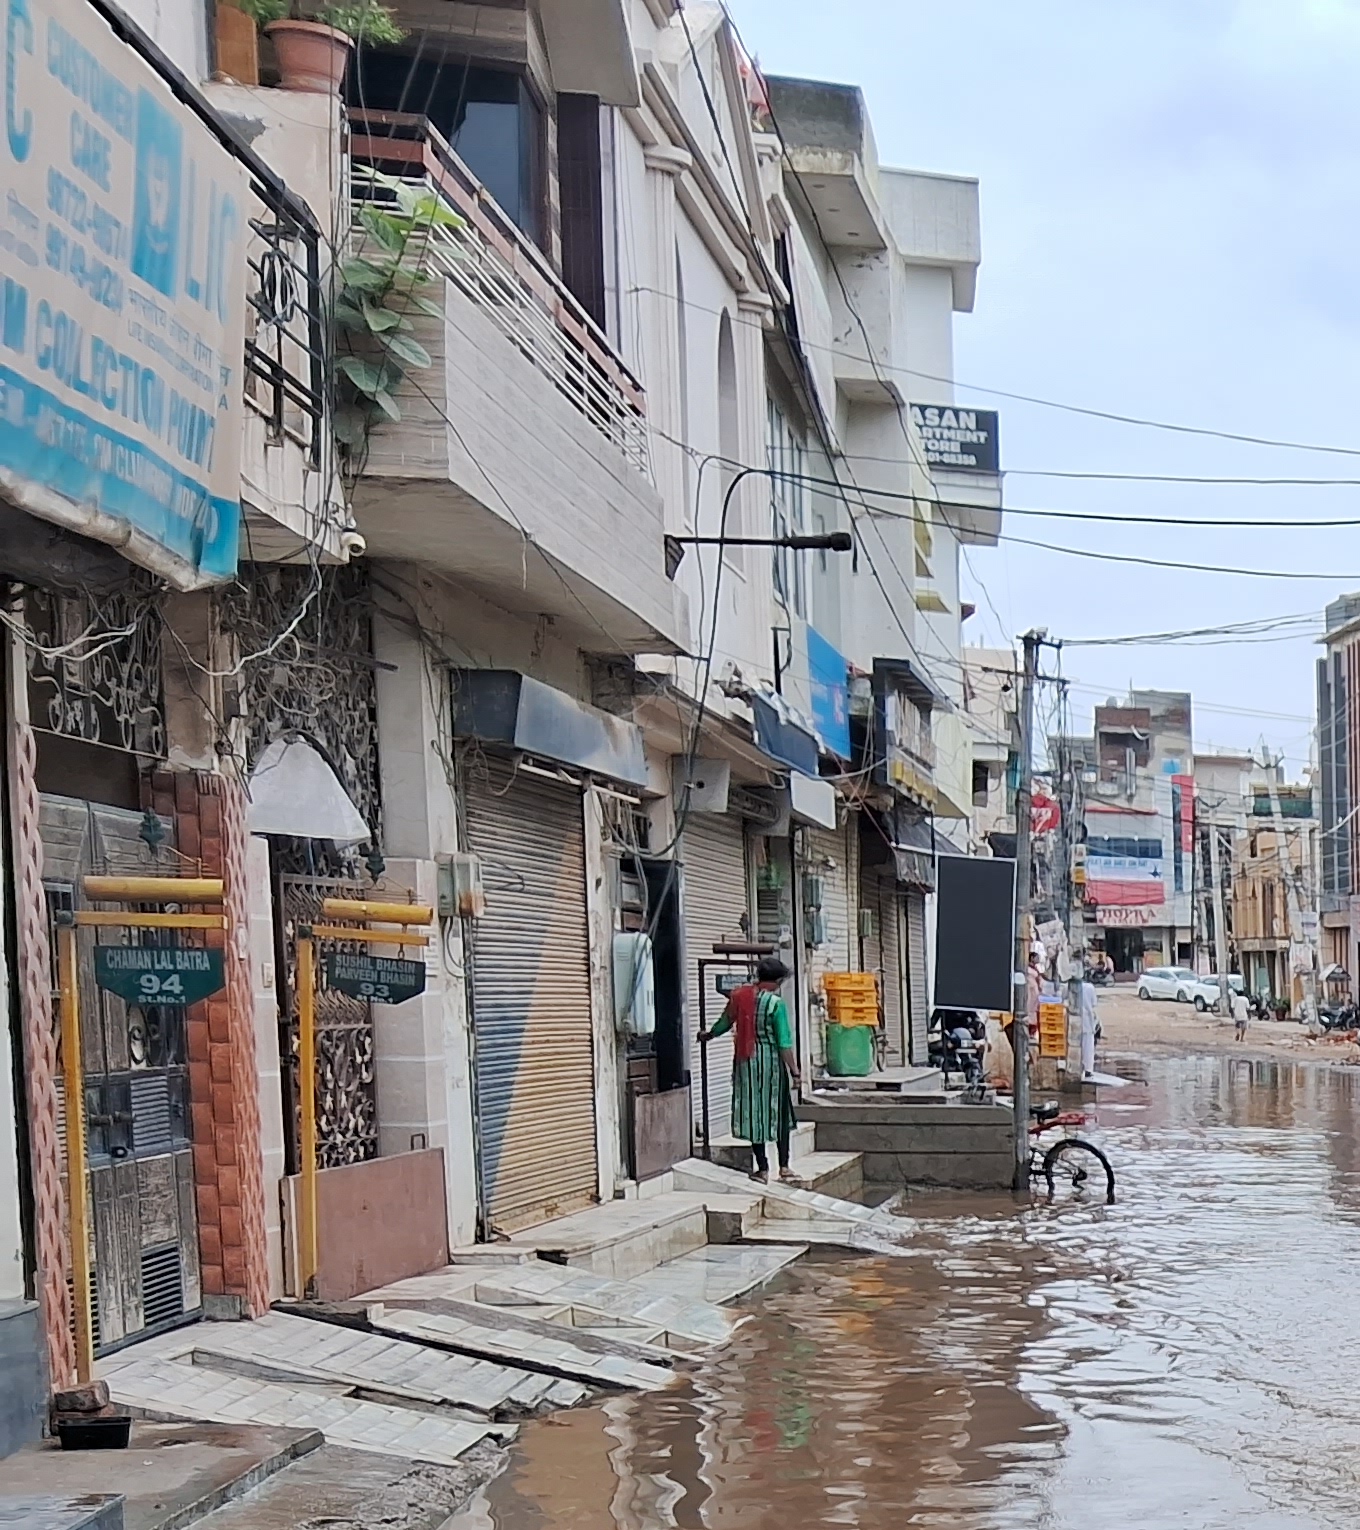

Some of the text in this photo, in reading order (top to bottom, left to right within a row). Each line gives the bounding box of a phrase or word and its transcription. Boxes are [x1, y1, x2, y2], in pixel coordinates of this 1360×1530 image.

[47, 15, 136, 148] CUSTOMER
[70, 108, 112, 193] CARE
[185, 156, 240, 326] LIC
[36, 298, 165, 442] COLLECTION
[166, 386, 216, 474] POINT
[106, 949, 211, 971] CHAMAN LAL BATRA
[335, 954, 416, 973] SUSHIL BHASIN
[140, 973, 184, 994] 94
[334, 966, 416, 987] PARVEEN BHASIN
[360, 982, 390, 998] 93
